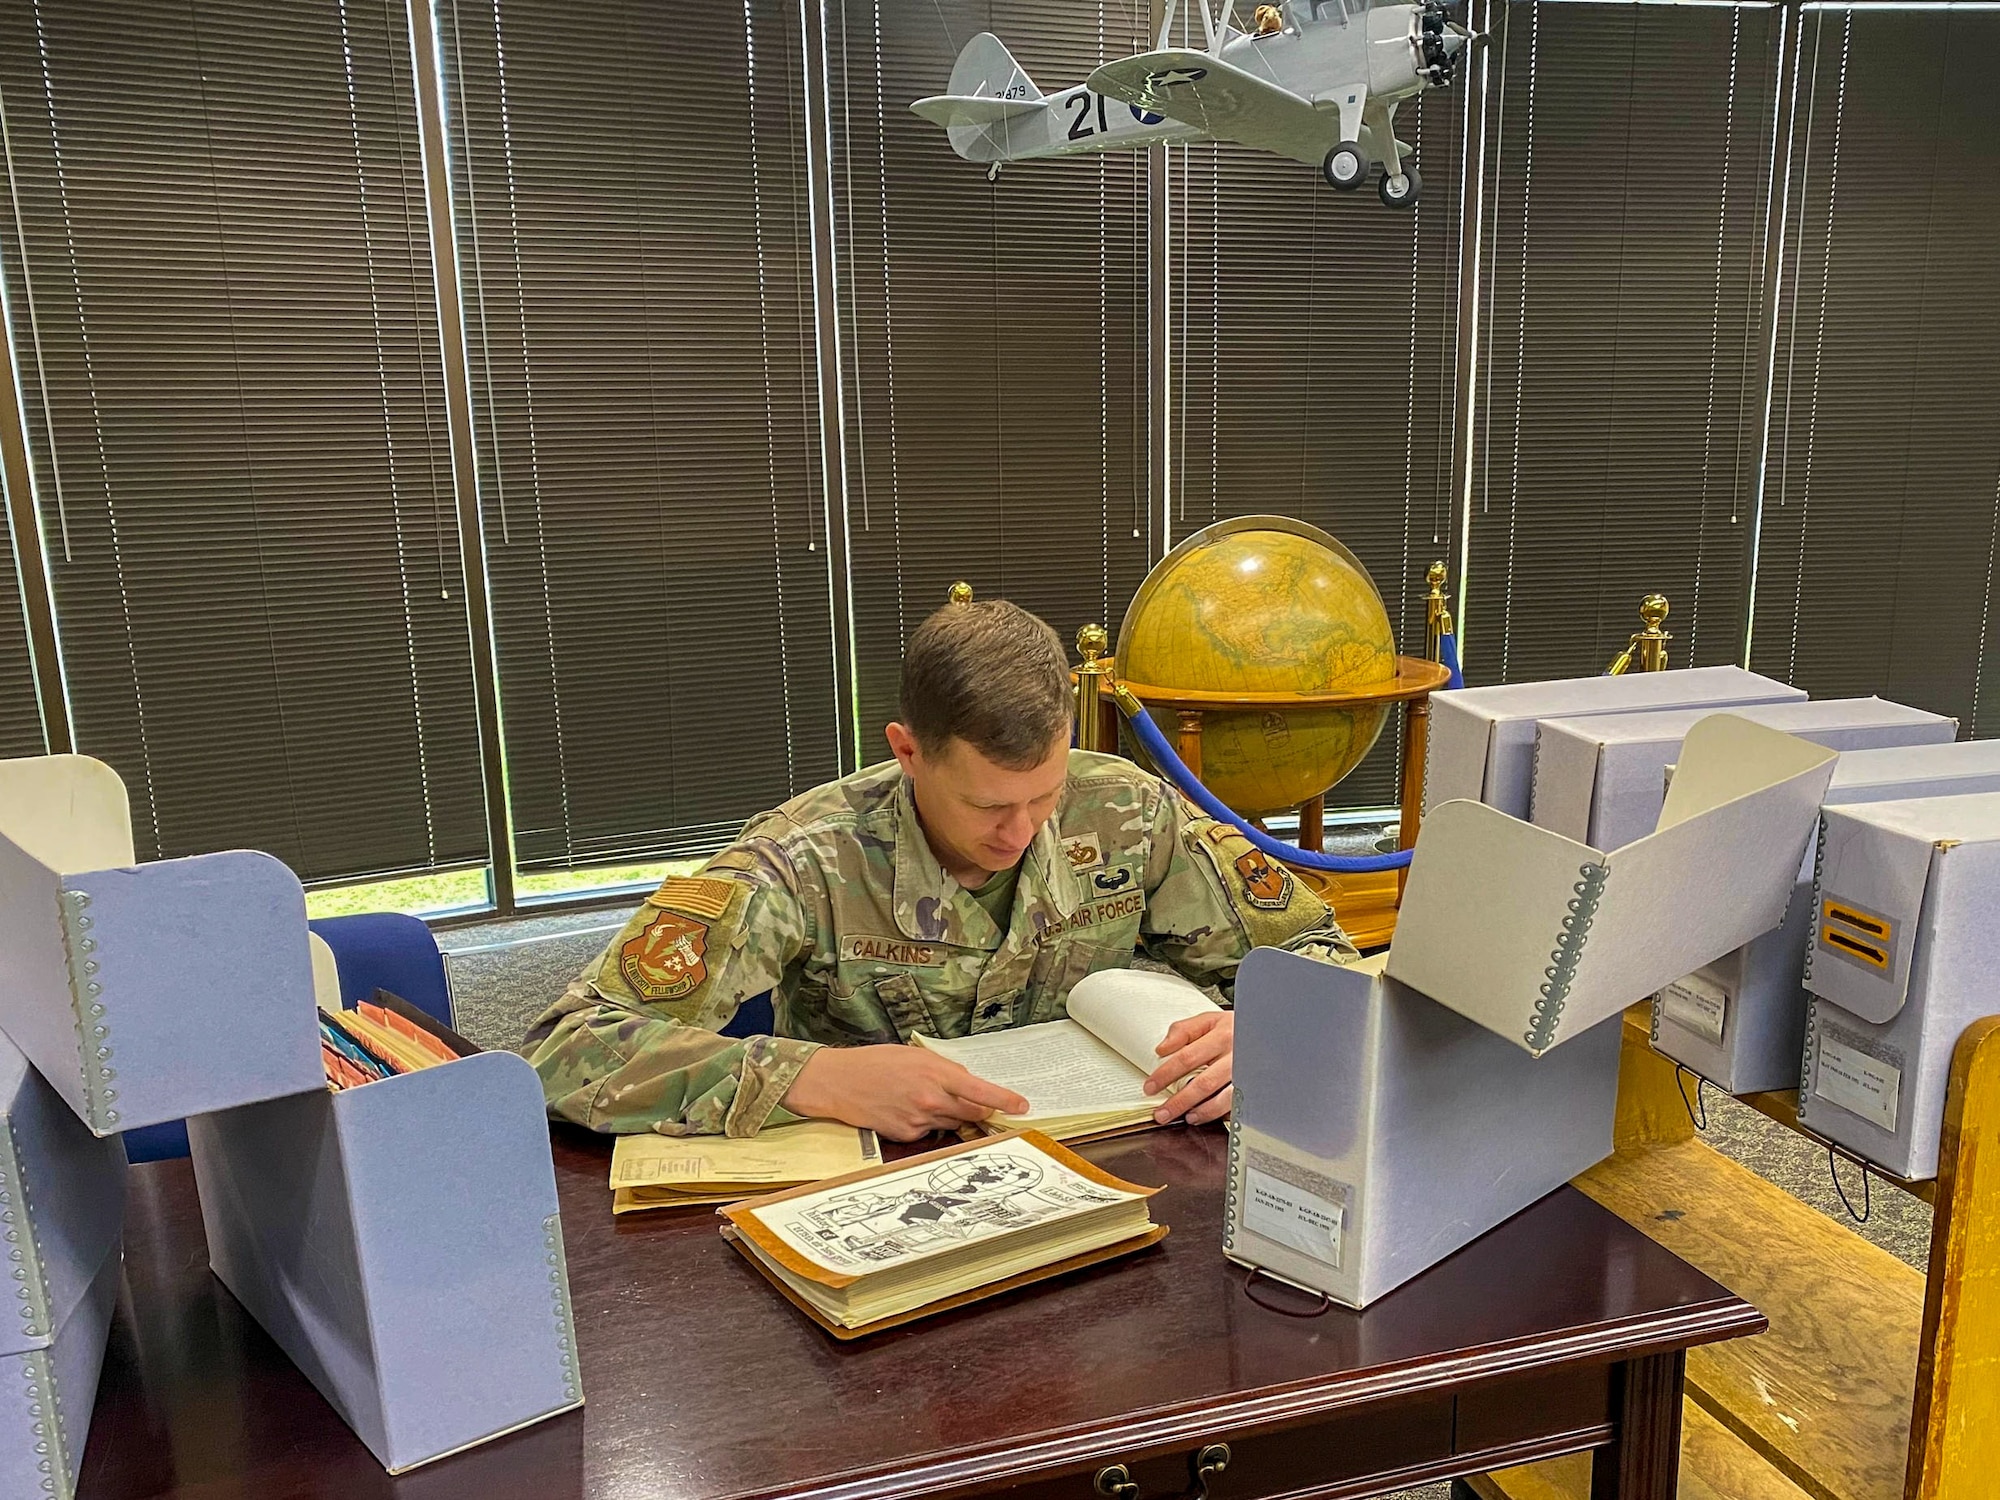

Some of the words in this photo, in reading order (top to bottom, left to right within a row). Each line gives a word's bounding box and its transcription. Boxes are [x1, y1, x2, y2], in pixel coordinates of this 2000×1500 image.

[1065, 91, 1108, 141] 21
[1070, 908, 1093, 928] AIR
[1097, 895, 1142, 922] FORCE
[853, 940, 931, 963] CALKINS
[651, 981, 687, 995] FELLOWSHIP
